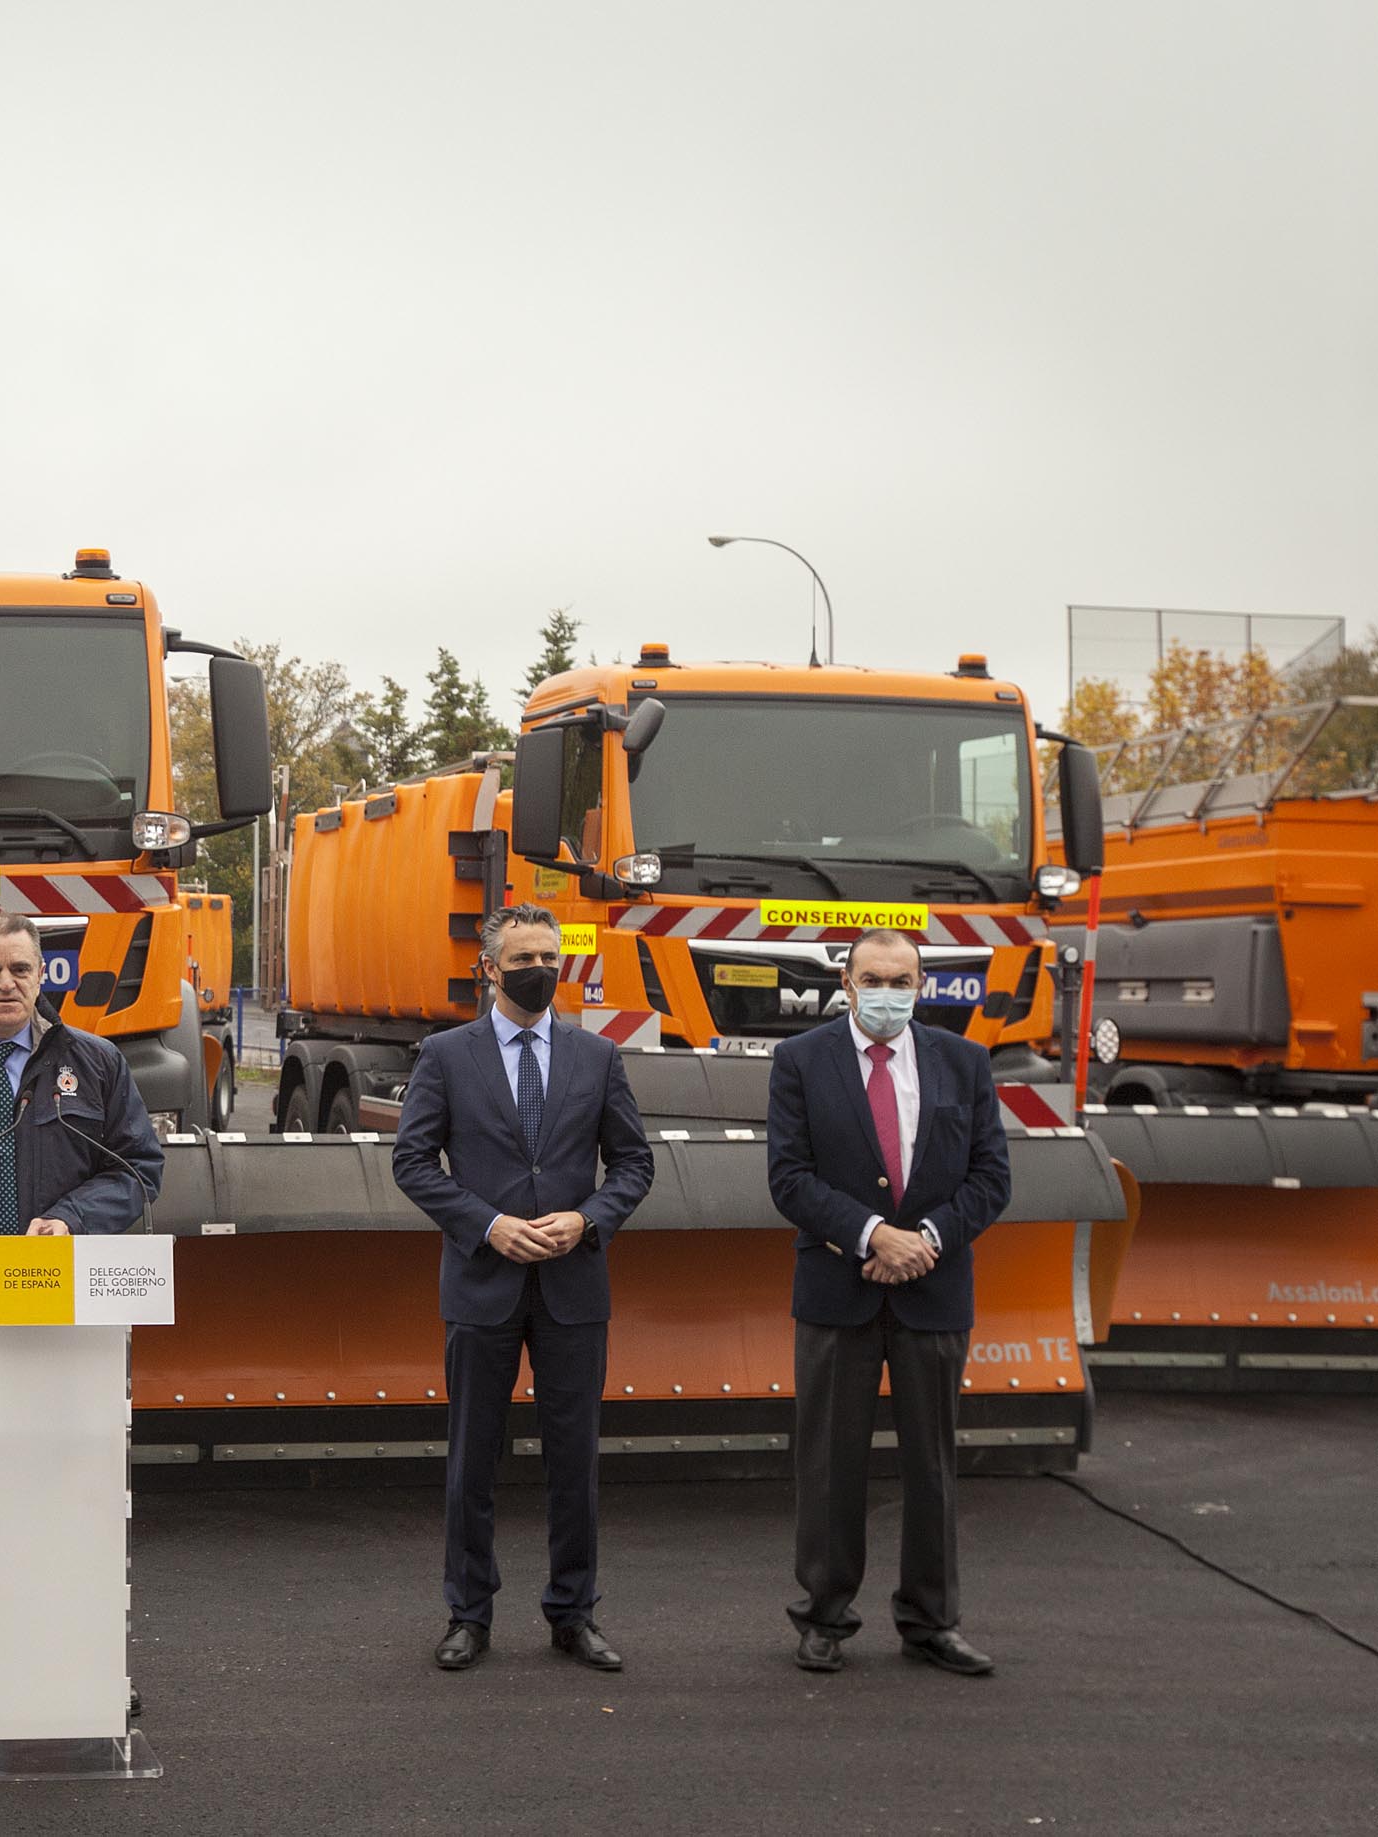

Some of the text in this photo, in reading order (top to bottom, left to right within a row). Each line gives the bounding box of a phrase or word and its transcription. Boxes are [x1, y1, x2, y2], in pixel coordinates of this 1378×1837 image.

[767, 909, 922, 927] CONSERVACIÓN
[584, 987, 604, 1002] M-40
[921, 976, 981, 1001] M-40
[780, 988, 851, 1015] MA
[4, 1268, 61, 1278] GOBIERNO
[89, 1265, 156, 1277] DELEGACIÓN
[4, 1278, 61, 1289] DE ESPAÑA
[89, 1277, 166, 1287] DEL GOBIERNO
[89, 1288, 148, 1297] EN MADRID
[1037, 1337, 1073, 1362] TE
